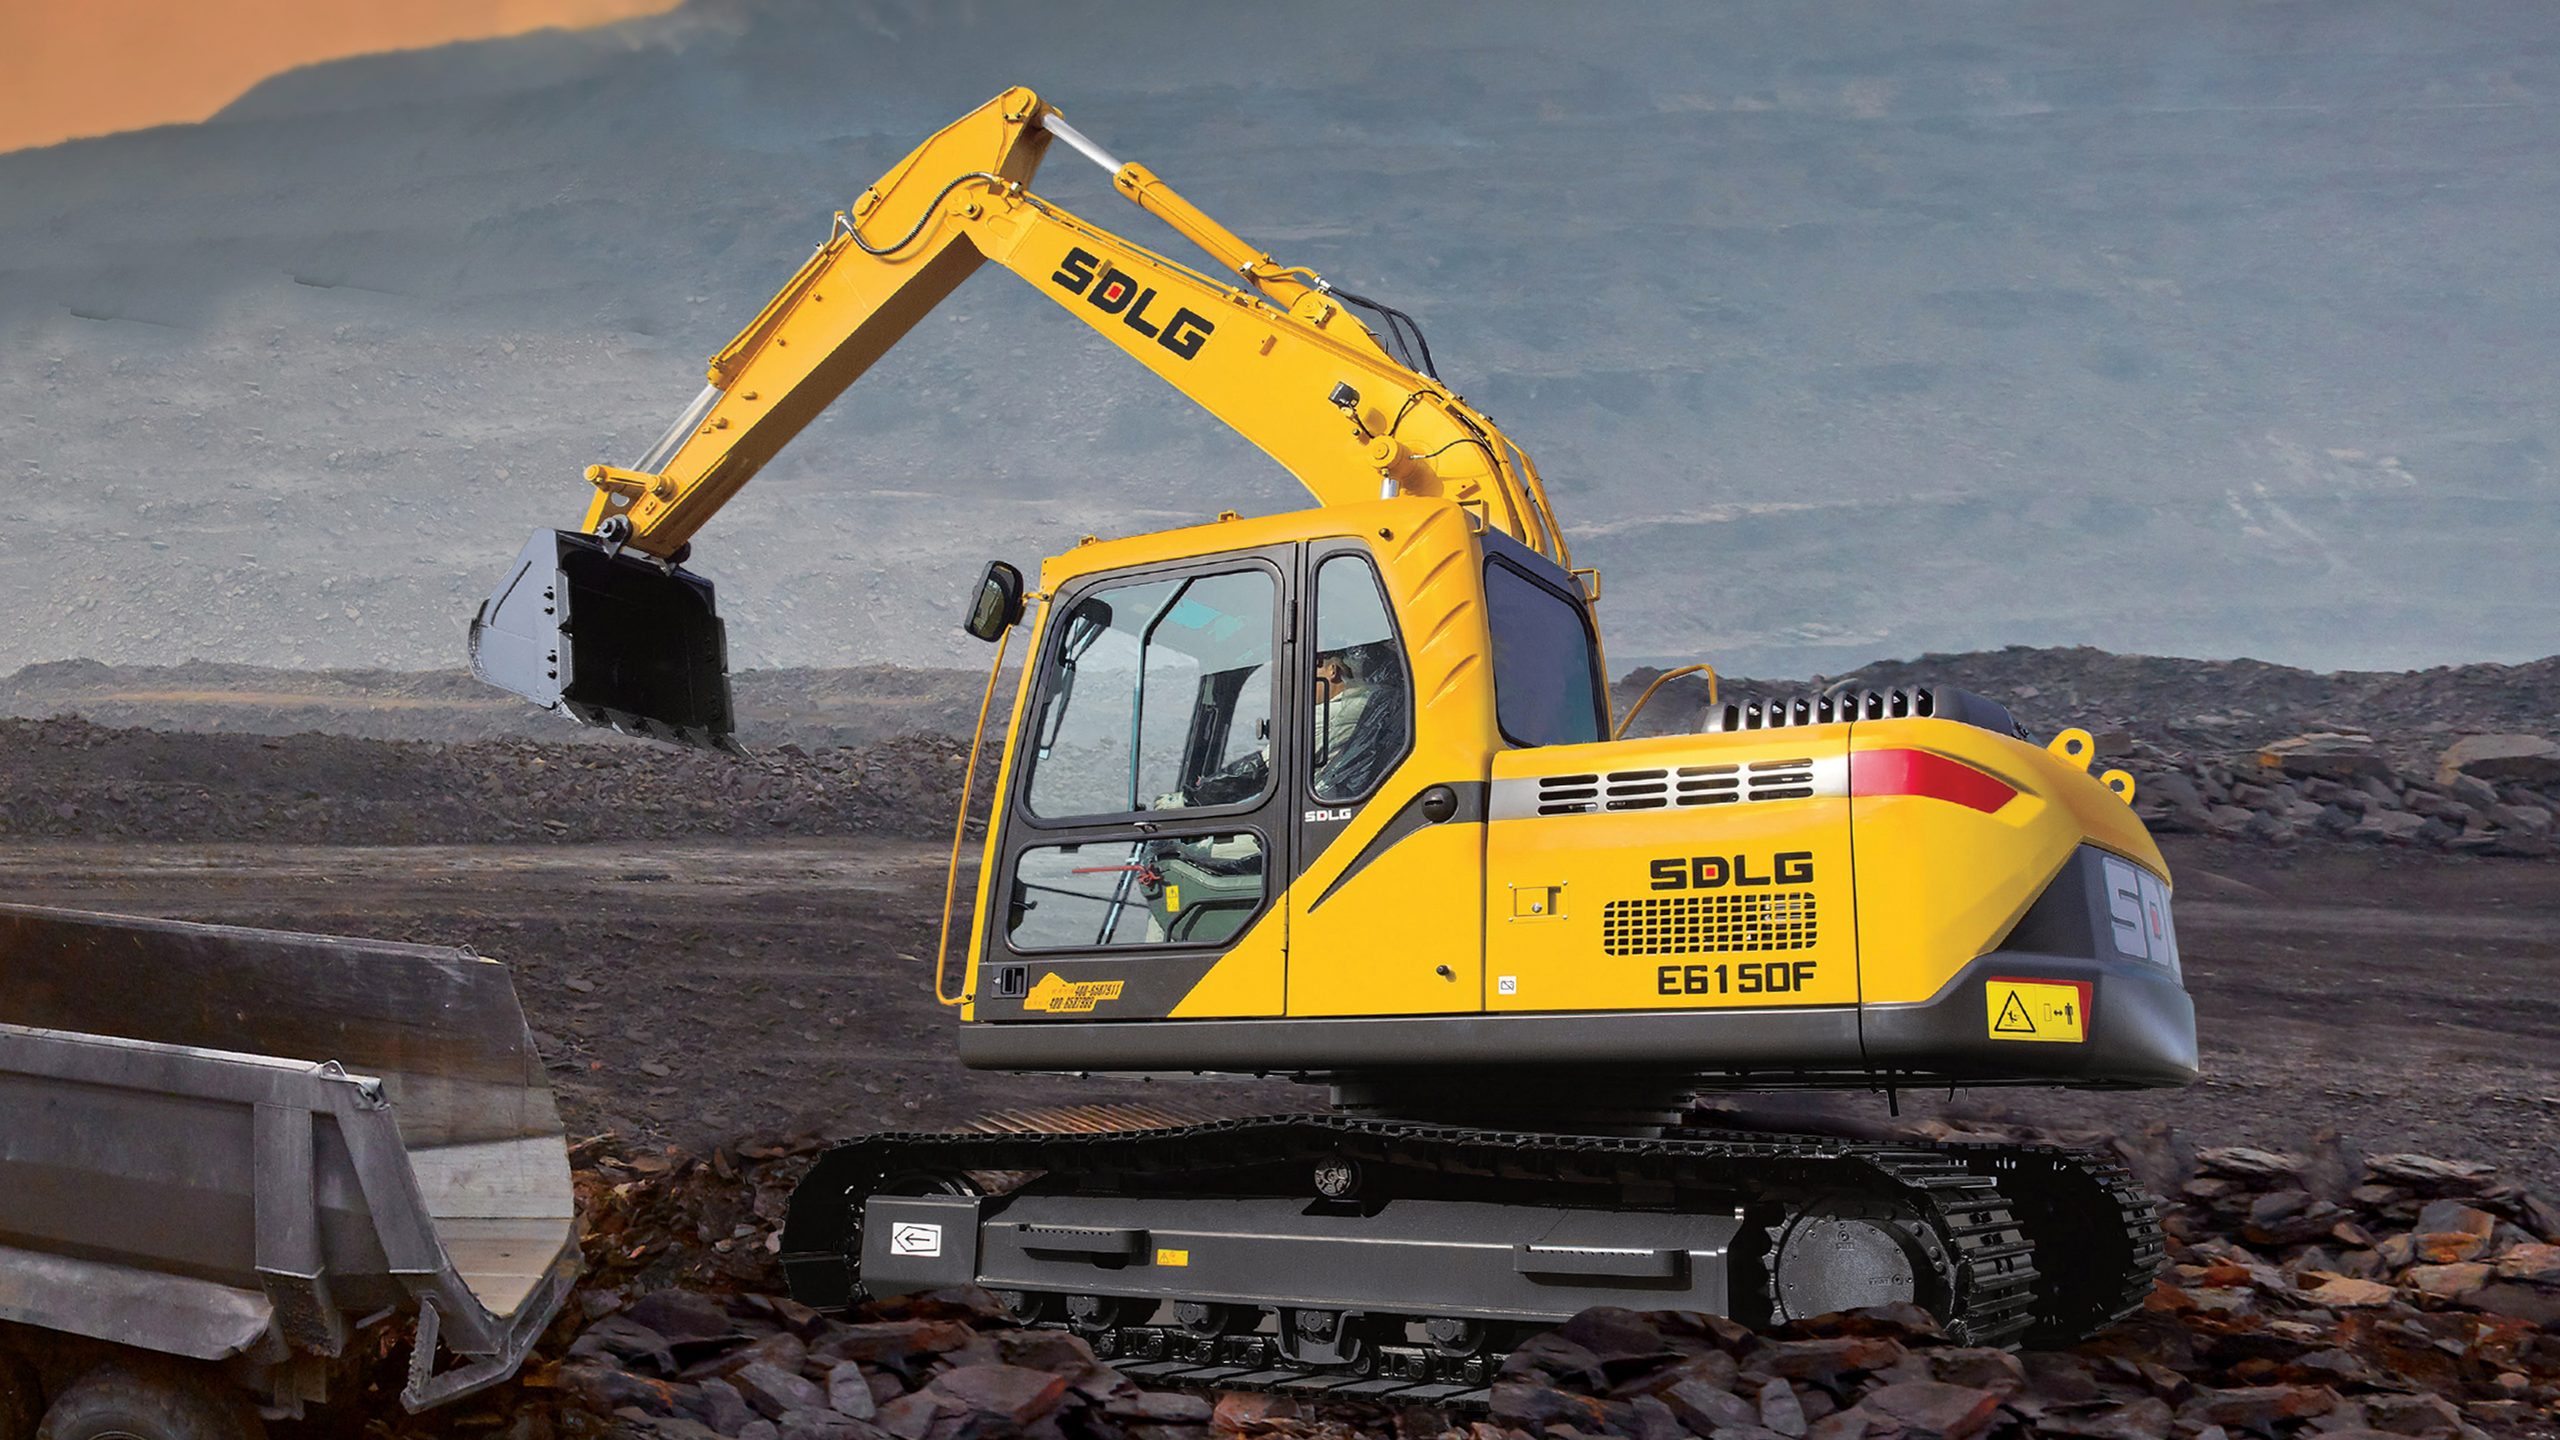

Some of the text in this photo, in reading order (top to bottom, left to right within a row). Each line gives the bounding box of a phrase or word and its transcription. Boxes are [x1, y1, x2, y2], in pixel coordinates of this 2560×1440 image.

[1052, 247, 1214, 360] SDLG
[1304, 808, 1351, 822] SDLG
[1650, 851, 1814, 890] SDLG
[1658, 961, 1817, 995] E6150F
